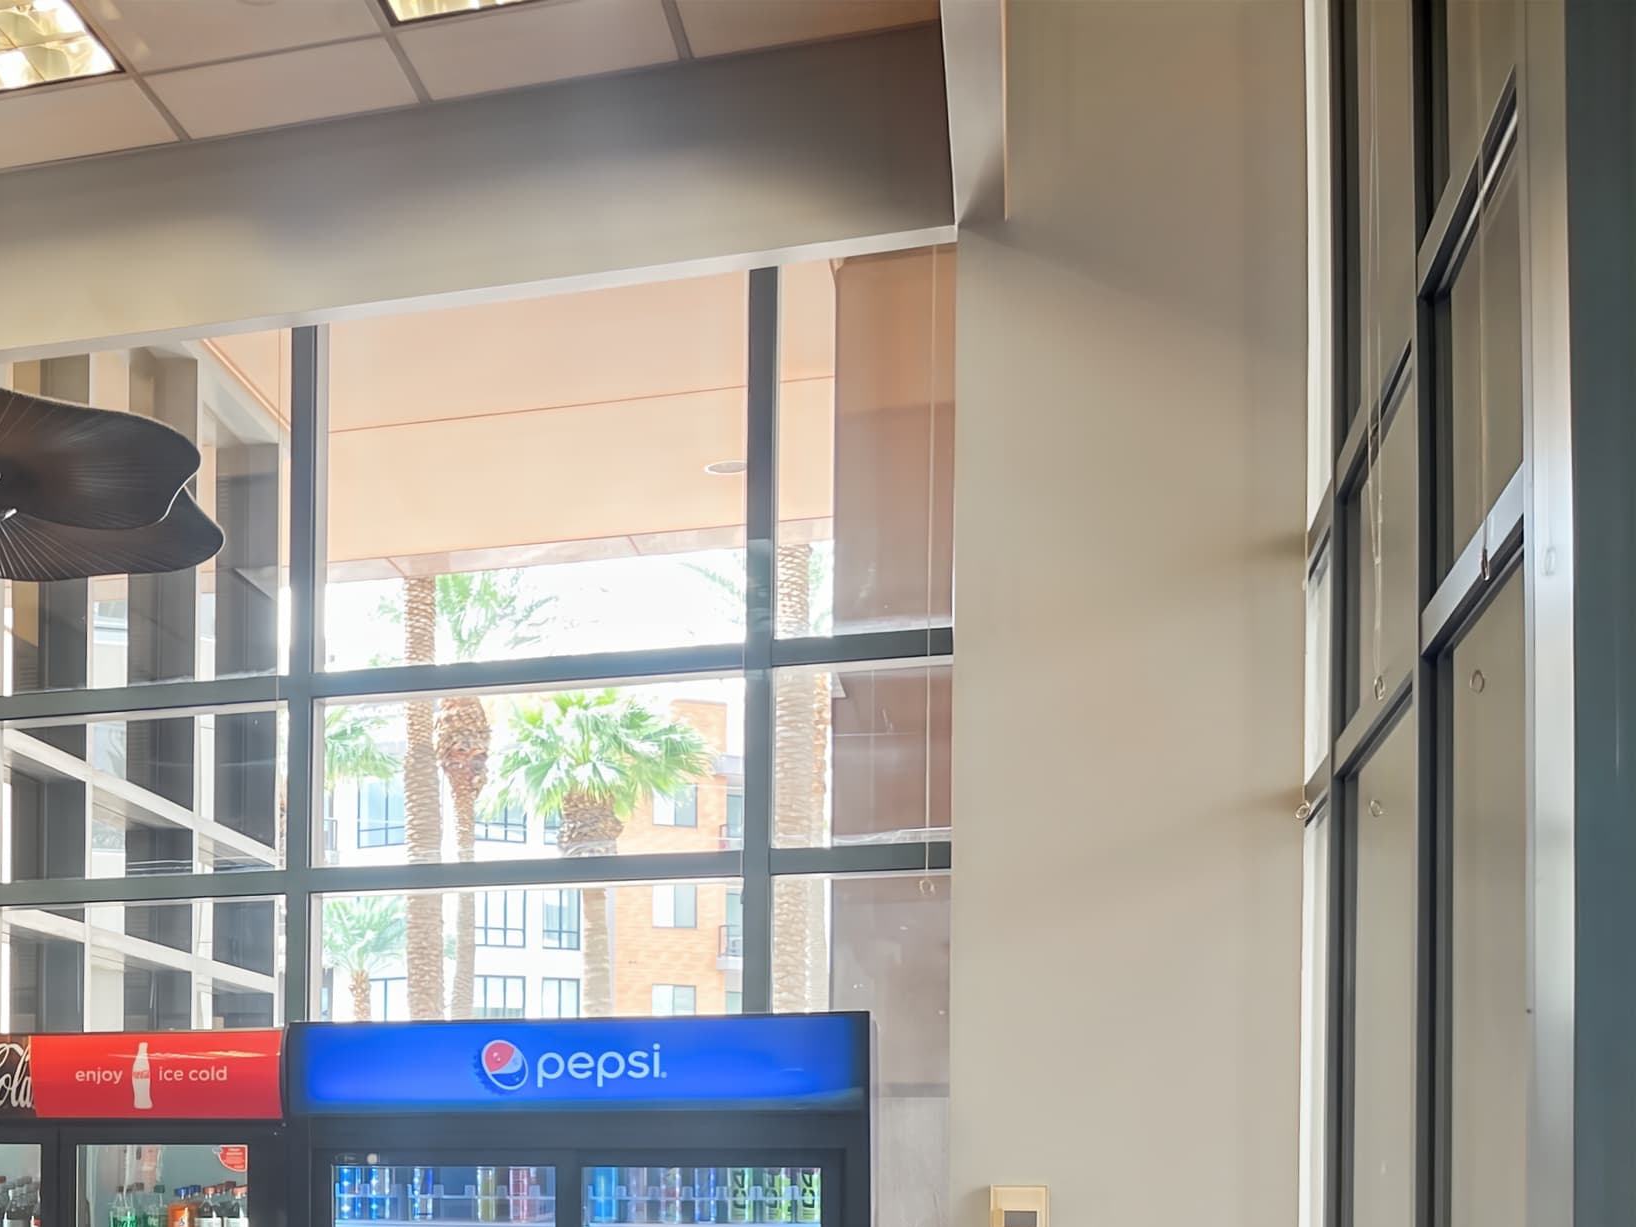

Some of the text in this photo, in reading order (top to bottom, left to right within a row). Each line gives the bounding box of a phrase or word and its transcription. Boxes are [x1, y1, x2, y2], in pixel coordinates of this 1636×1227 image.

[75, 1066, 123, 1085] enjoy
[158, 1065, 184, 1081] ice
[188, 1066, 228, 1081] cold
[537, 1043, 661, 1088] pepsi
